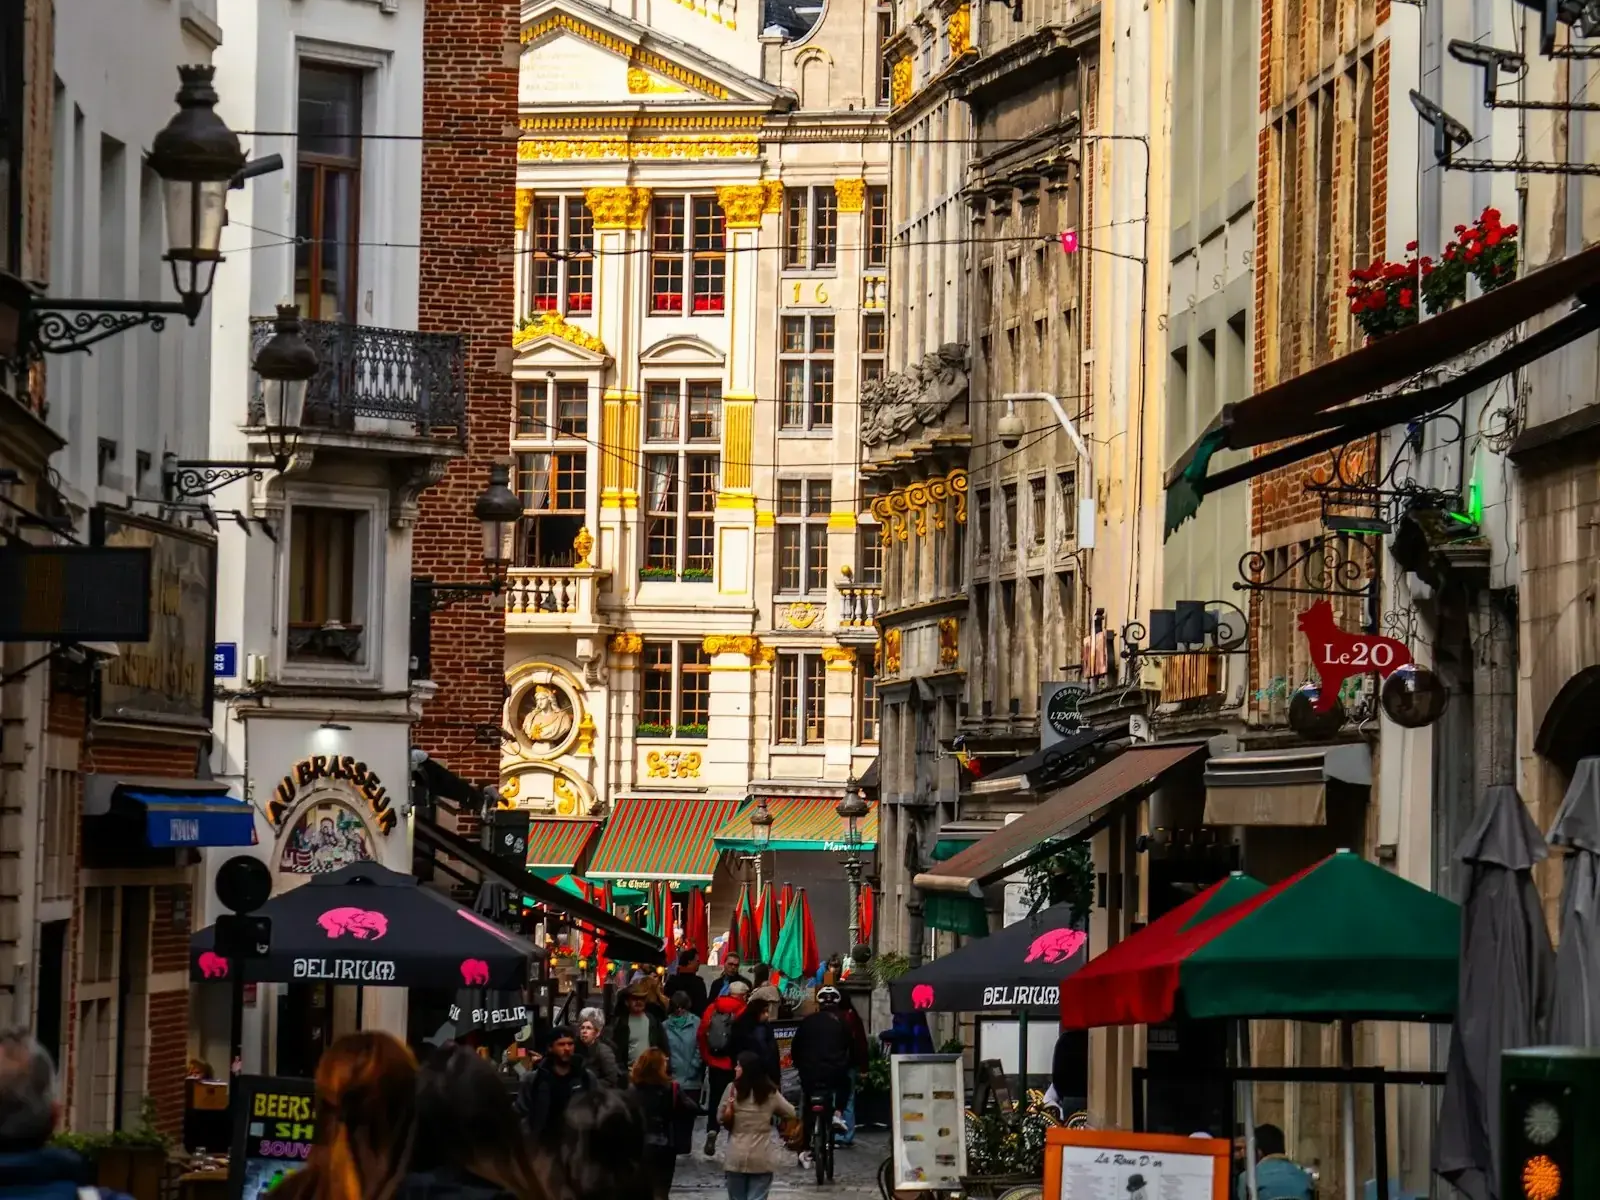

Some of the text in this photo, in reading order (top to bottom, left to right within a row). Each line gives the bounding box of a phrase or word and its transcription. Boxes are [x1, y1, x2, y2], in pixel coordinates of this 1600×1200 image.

[266, 754, 397, 837] AU BRASSEUR
[293, 958, 396, 981] DELIRIUM
[983, 986, 1060, 1006] DELIRIUM
[254, 1092, 311, 1121] BEERS
[1094, 1152, 1110, 1164] La
